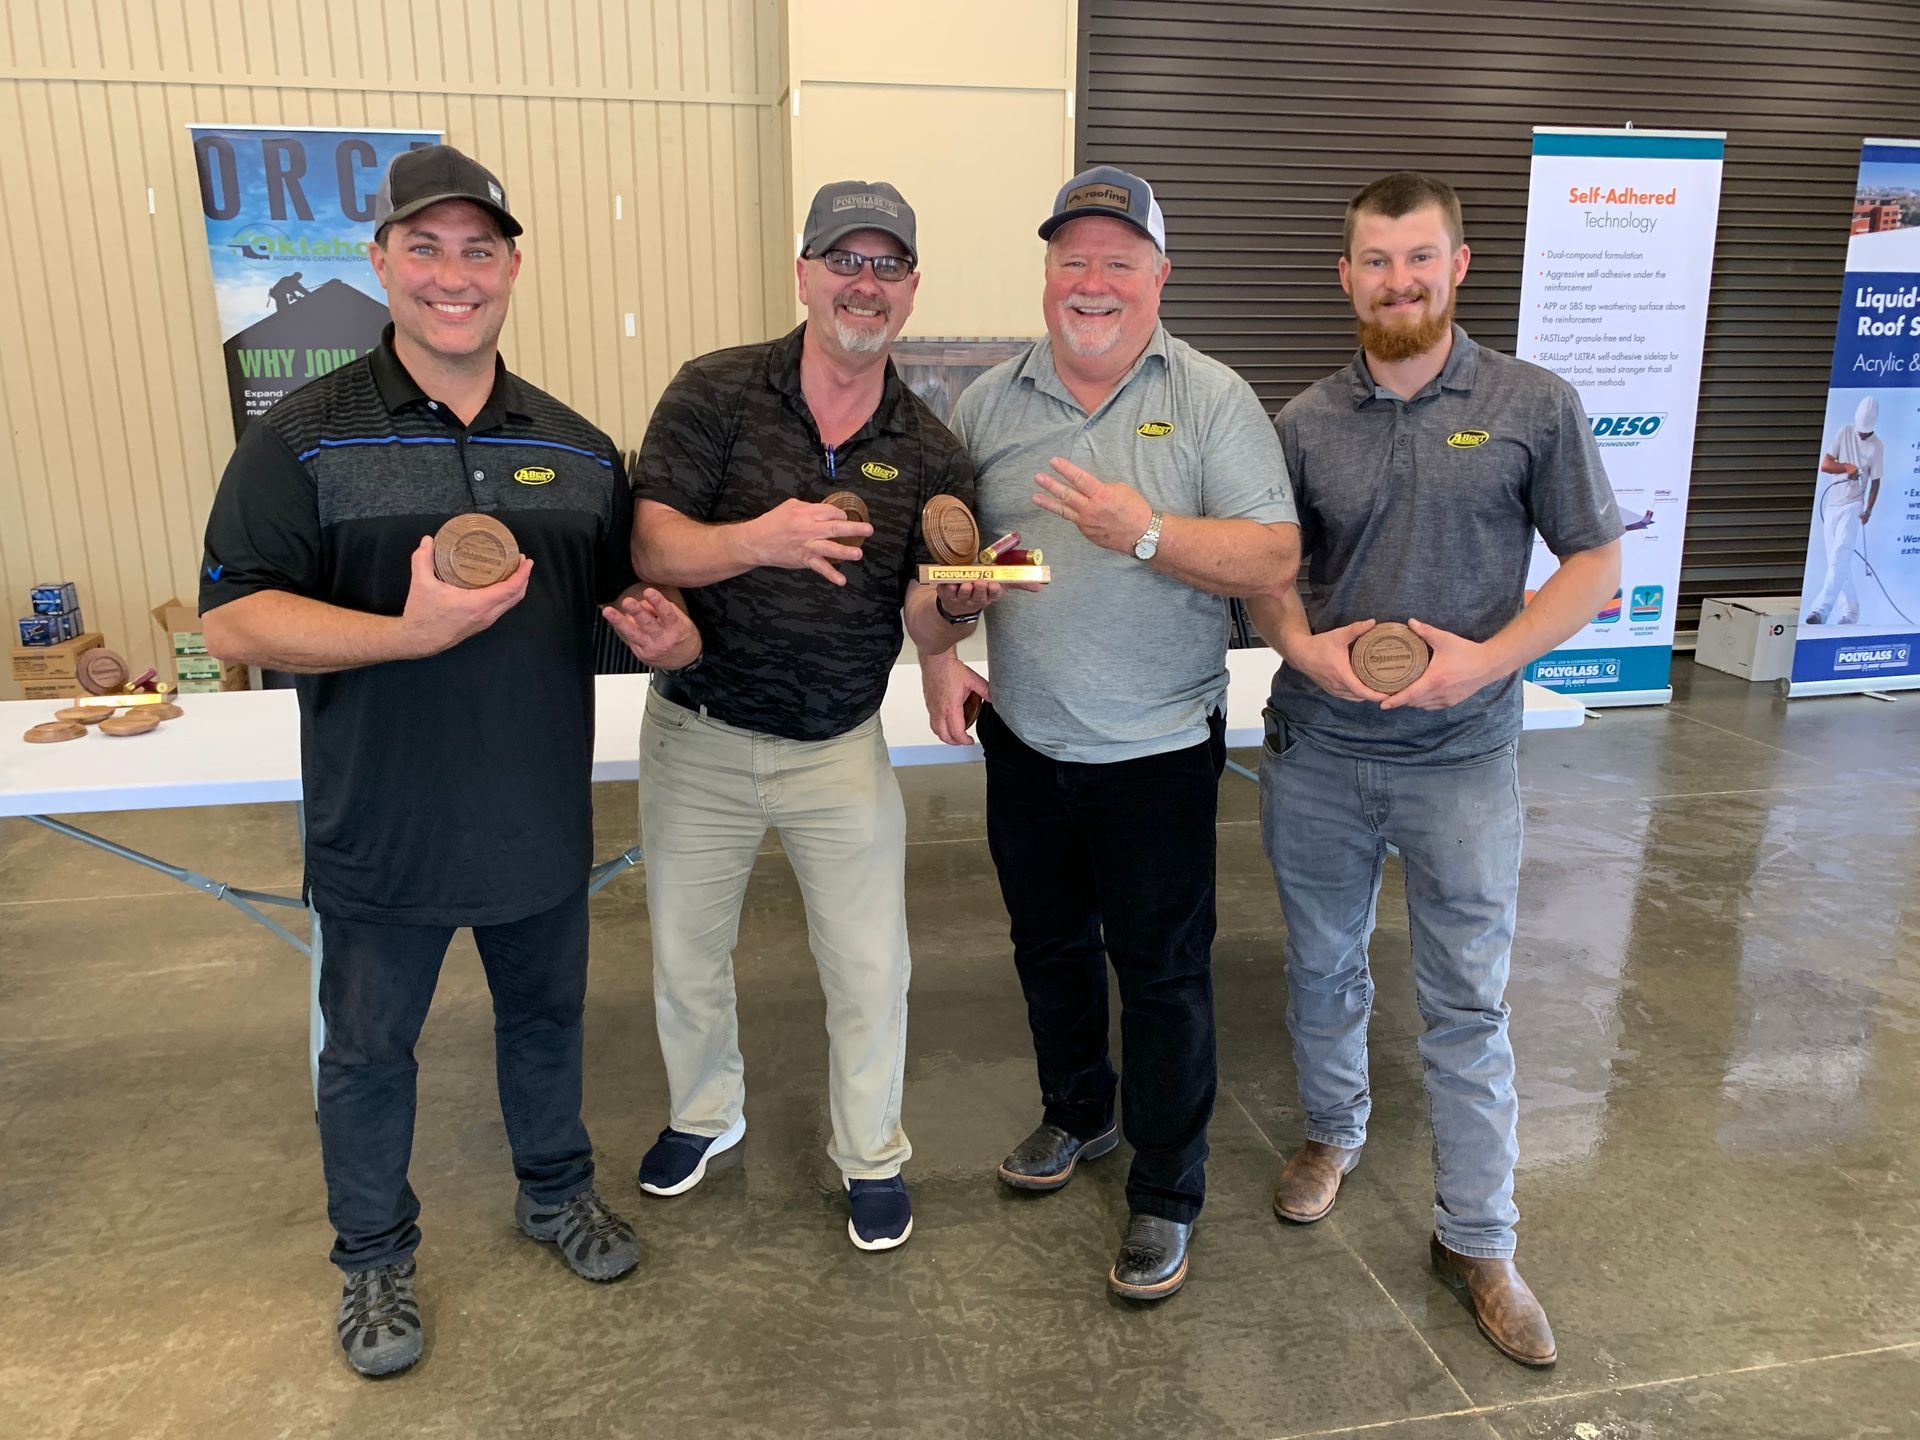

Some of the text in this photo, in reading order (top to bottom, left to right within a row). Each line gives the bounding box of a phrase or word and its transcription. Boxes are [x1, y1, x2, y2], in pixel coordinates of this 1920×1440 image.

[194, 136, 433, 223] ORC
[1085, 190, 1127, 204] roofing
[1569, 187, 1676, 205] Self-Adhered
[1584, 211, 1657, 233] Technology
[250, 235, 369, 256] Oklaho
[1547, 250, 1643, 260] Dual-compound formulation
[1546, 269, 1666, 280] Aggressive self-adhesive under the
[1544, 282, 1592, 291] reinforcement
[1543, 302, 1557, 310] APP
[1569, 302, 1582, 310] SBS
[1584, 303, 1596, 312] top
[1598, 302, 1636, 312] weathering
[1638, 302, 1663, 310] surface
[1665, 302, 1686, 310] above
[1542, 315, 1602, 323] the reinforcement
[1857, 315, 1906, 336] Roof
[1575, 334, 1617, 344] granule-free
[1618, 334, 1632, 342] end
[1633, 334, 1645, 344] lap
[1574, 352, 1596, 360] ULTRA
[1598, 352, 1642, 361] self-adhesive
[1643, 352, 1668, 362] sidelap
[1669, 352, 1679, 360] for
[238, 349, 295, 378] WHY
[1852, 352, 1905, 377] Acrylic
[1573, 365, 1594, 375] bond,
[1596, 366, 1616, 374] tested
[1617, 366, 1646, 375] stronger
[1647, 365, 1662, 373] than
[1664, 364, 1673, 373] all
[1571, 379, 1626, 388] lication methods
[244, 390, 283, 399] Expand
[1837, 650, 1892, 662] POLYGLASS
[1537, 665, 1600, 678] POLYGLASS
